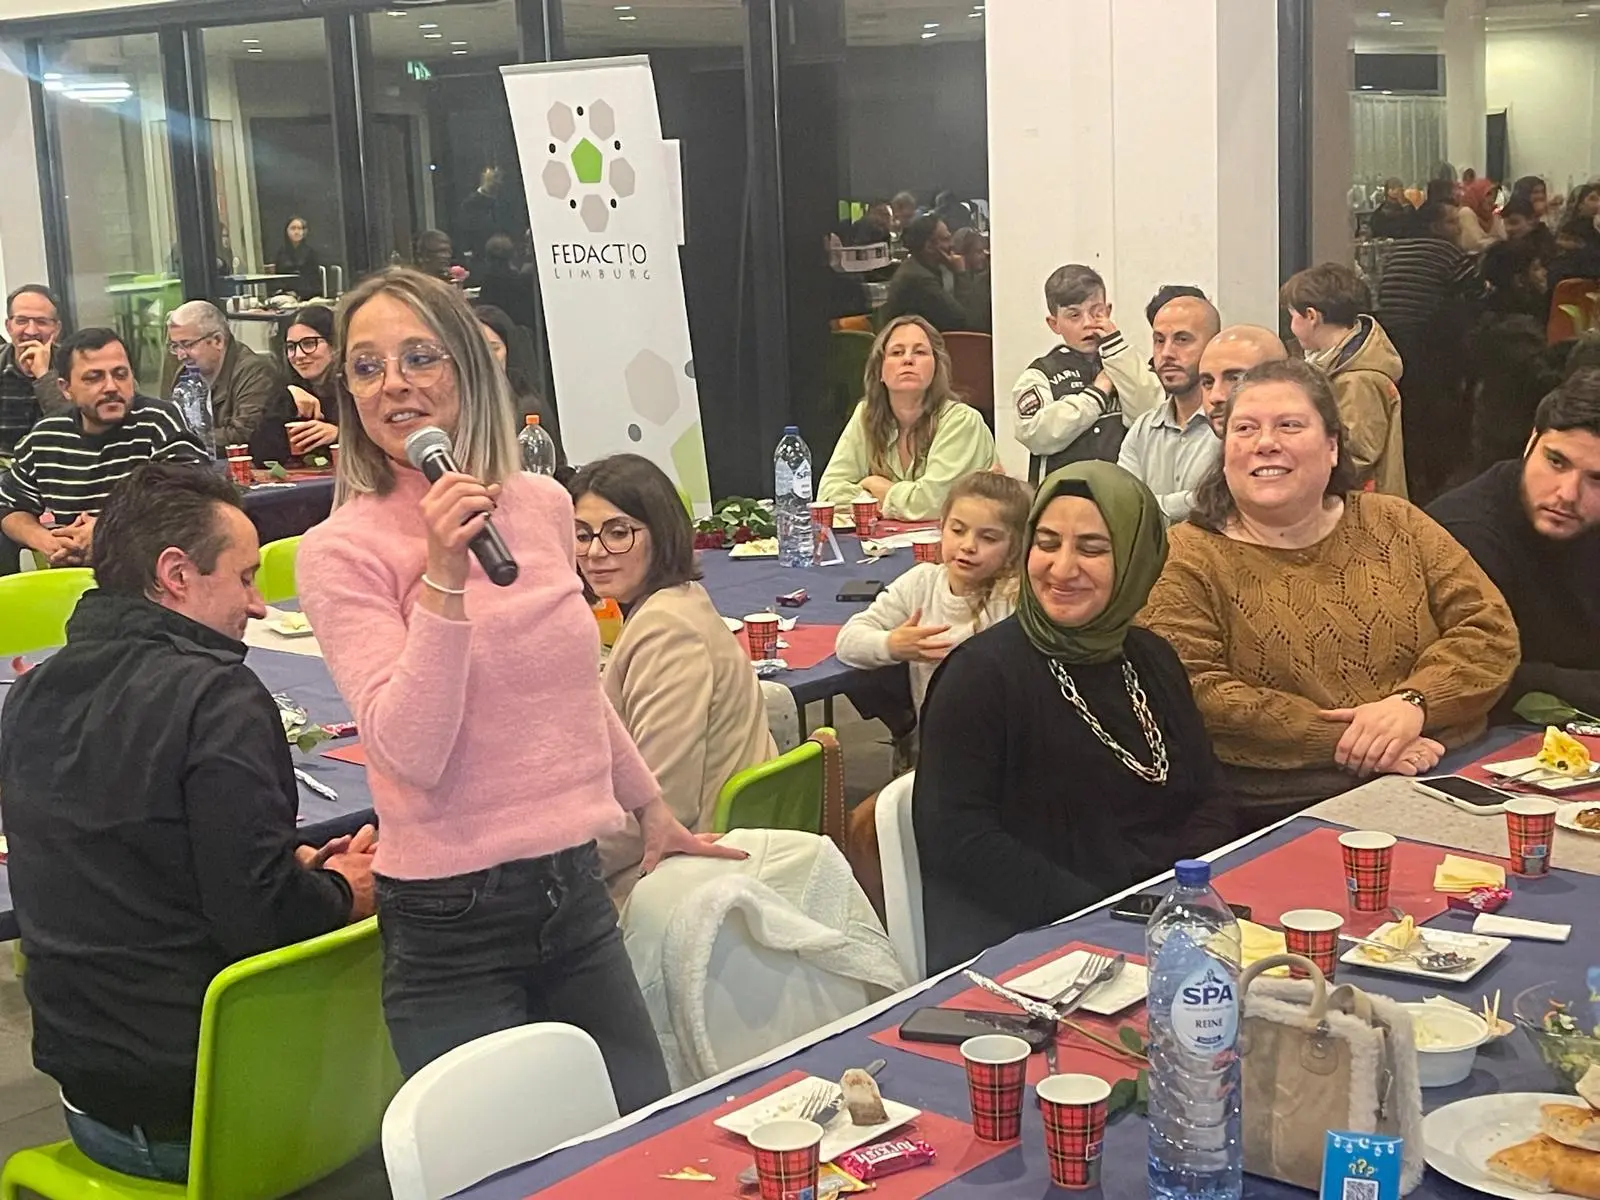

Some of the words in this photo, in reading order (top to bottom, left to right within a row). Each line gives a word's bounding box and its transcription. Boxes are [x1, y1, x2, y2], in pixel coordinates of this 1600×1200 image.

[554, 268, 650, 280] LIMBURG
[1183, 984, 1233, 1005] SPA
[1195, 1018, 1223, 1029] REINE
